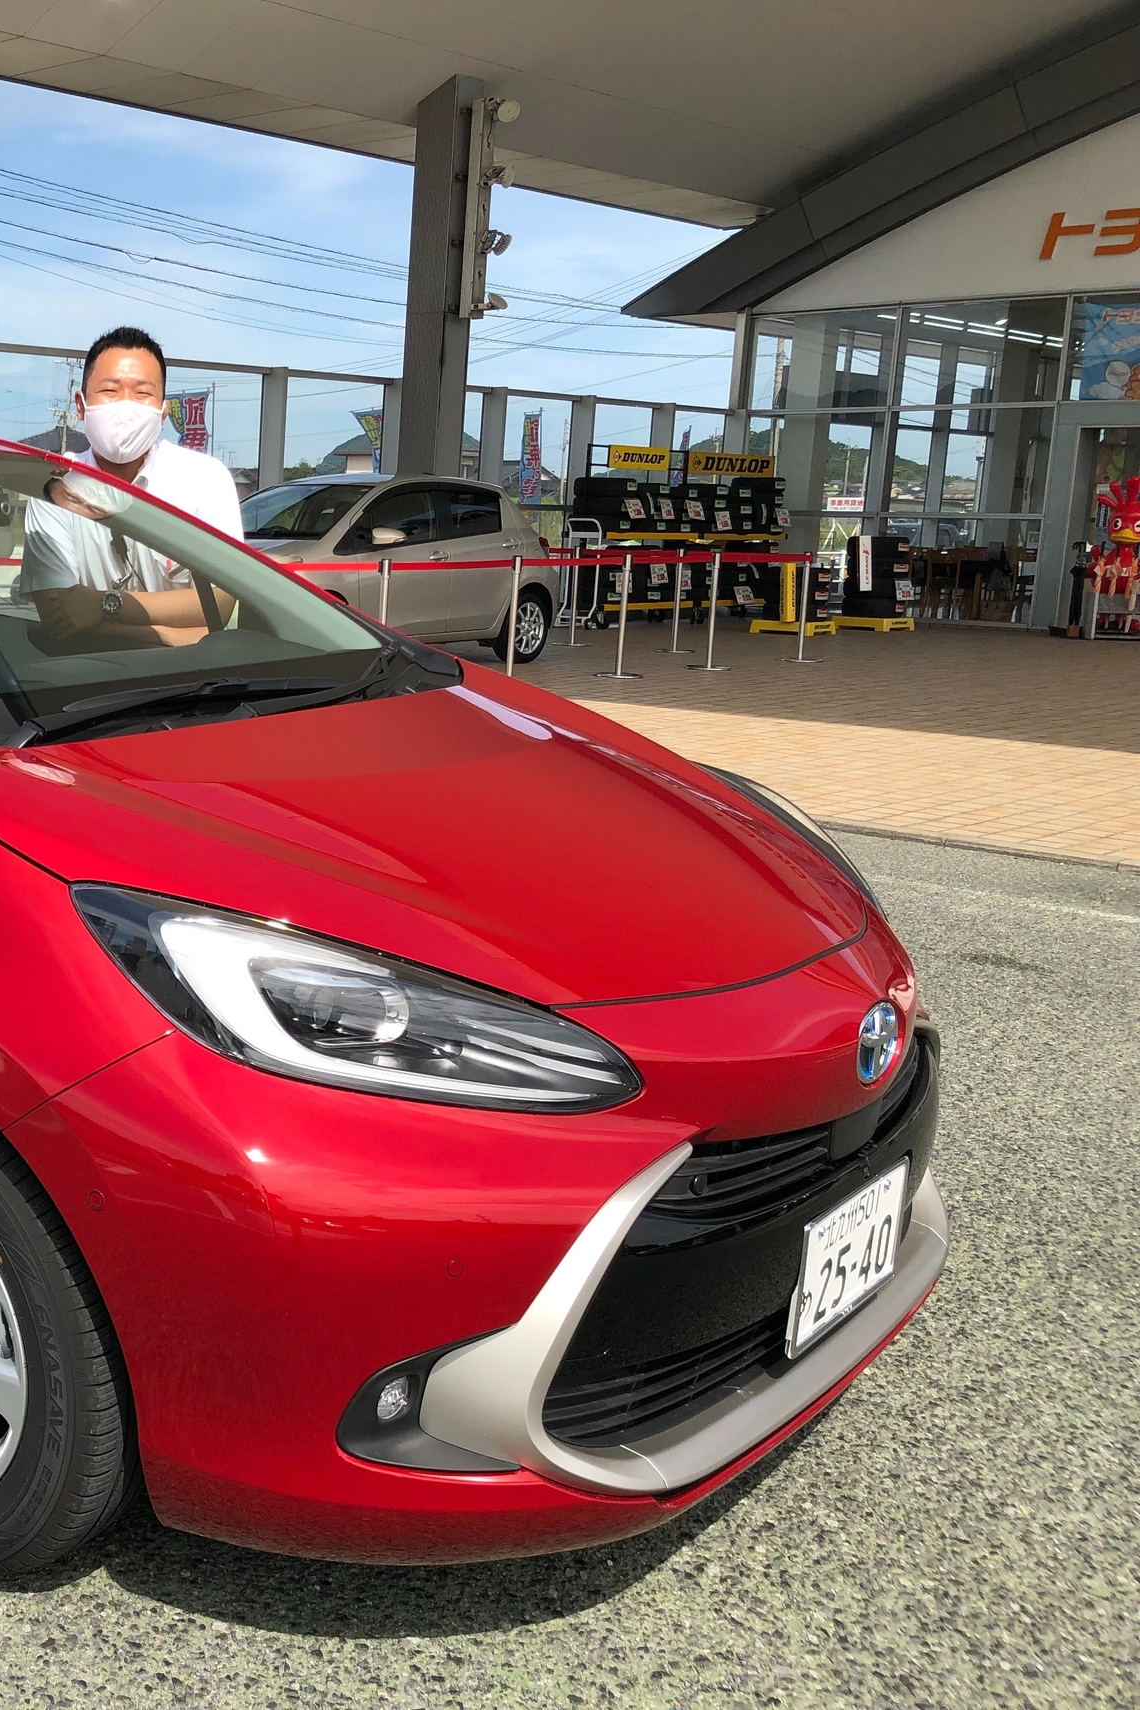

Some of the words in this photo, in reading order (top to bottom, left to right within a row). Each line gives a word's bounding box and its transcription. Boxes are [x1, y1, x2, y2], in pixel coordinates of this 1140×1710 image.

[1039, 207, 1140, 260] トヨ
[621, 452, 666, 465] DUNLOP
[702, 456, 770, 474] DUNLOP
[824, 1199, 859, 1251] 北九州
[857, 1183, 882, 1227] 501
[813, 1213, 892, 1325] 25-40
[32, 1303, 63, 1459] ENASAVE
